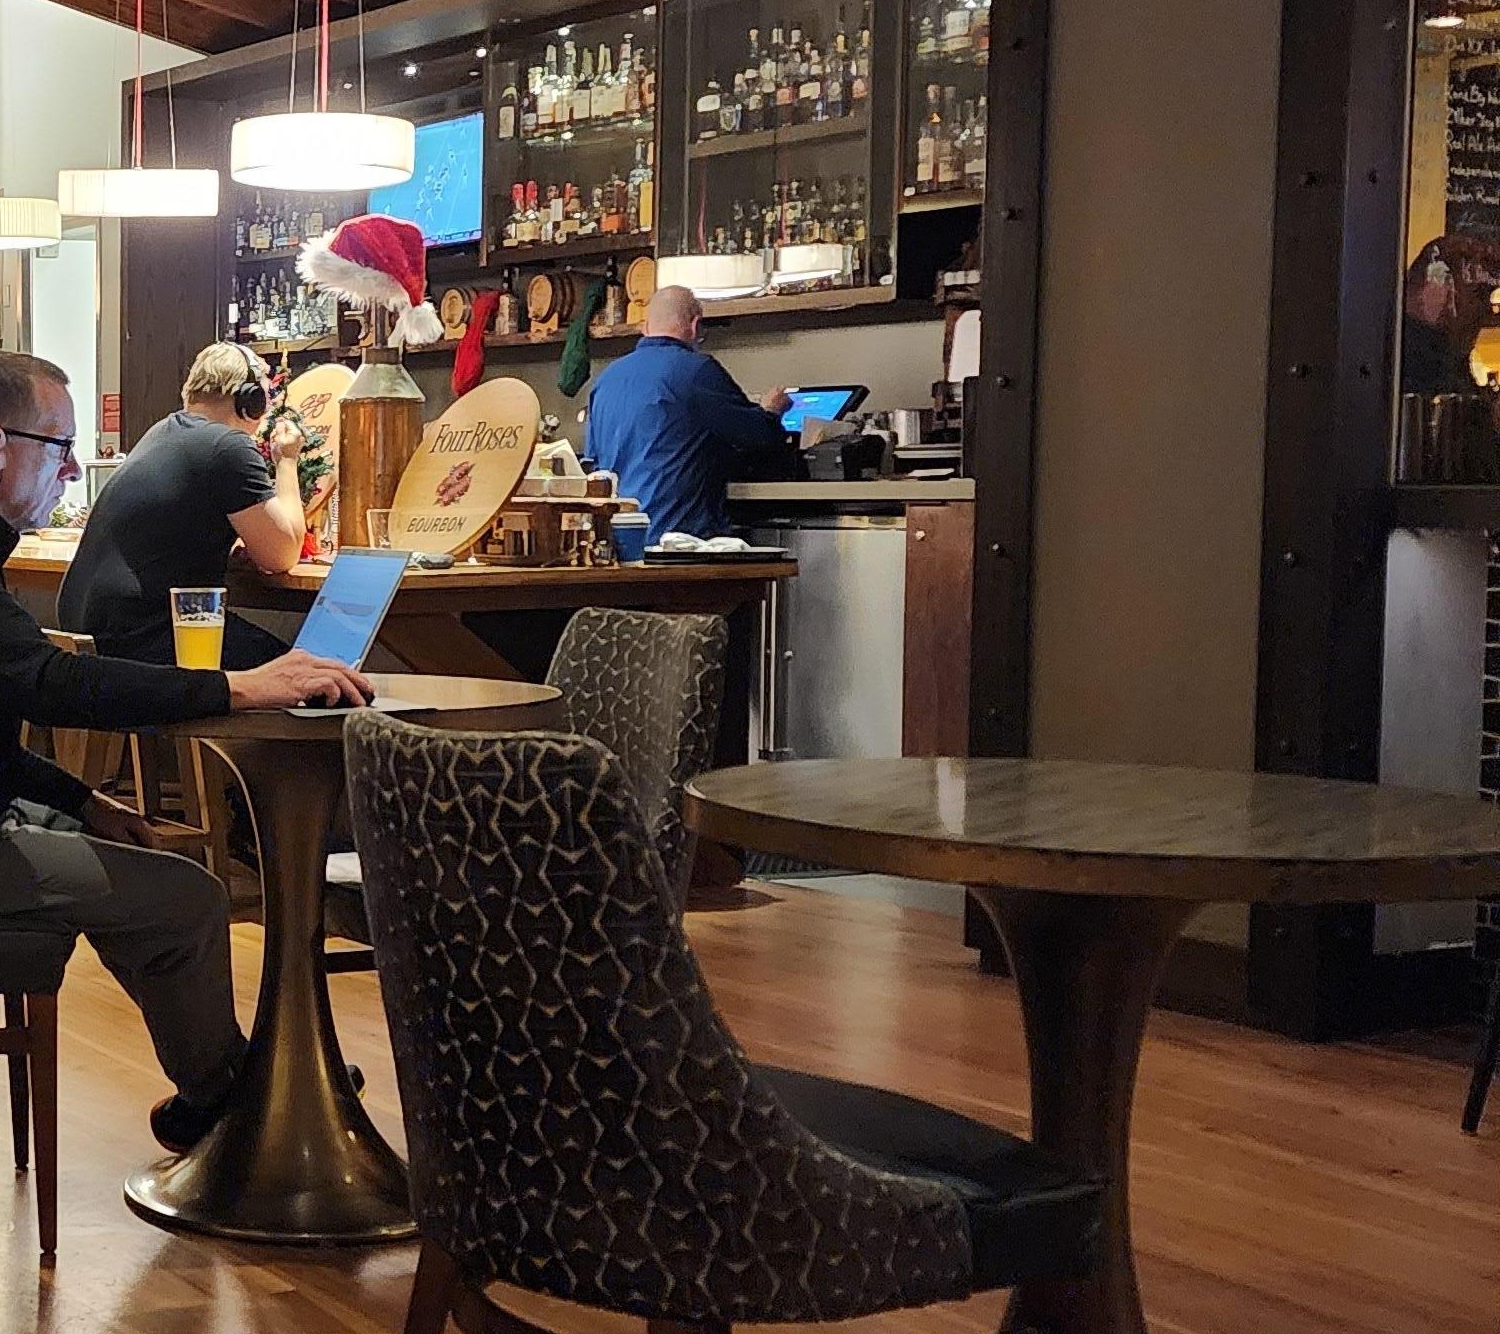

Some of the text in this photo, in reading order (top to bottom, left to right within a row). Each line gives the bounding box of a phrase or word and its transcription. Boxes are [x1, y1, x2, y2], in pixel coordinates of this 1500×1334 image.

[428, 421, 524, 454] Four Roses
[406, 516, 468, 533] BOURBON
